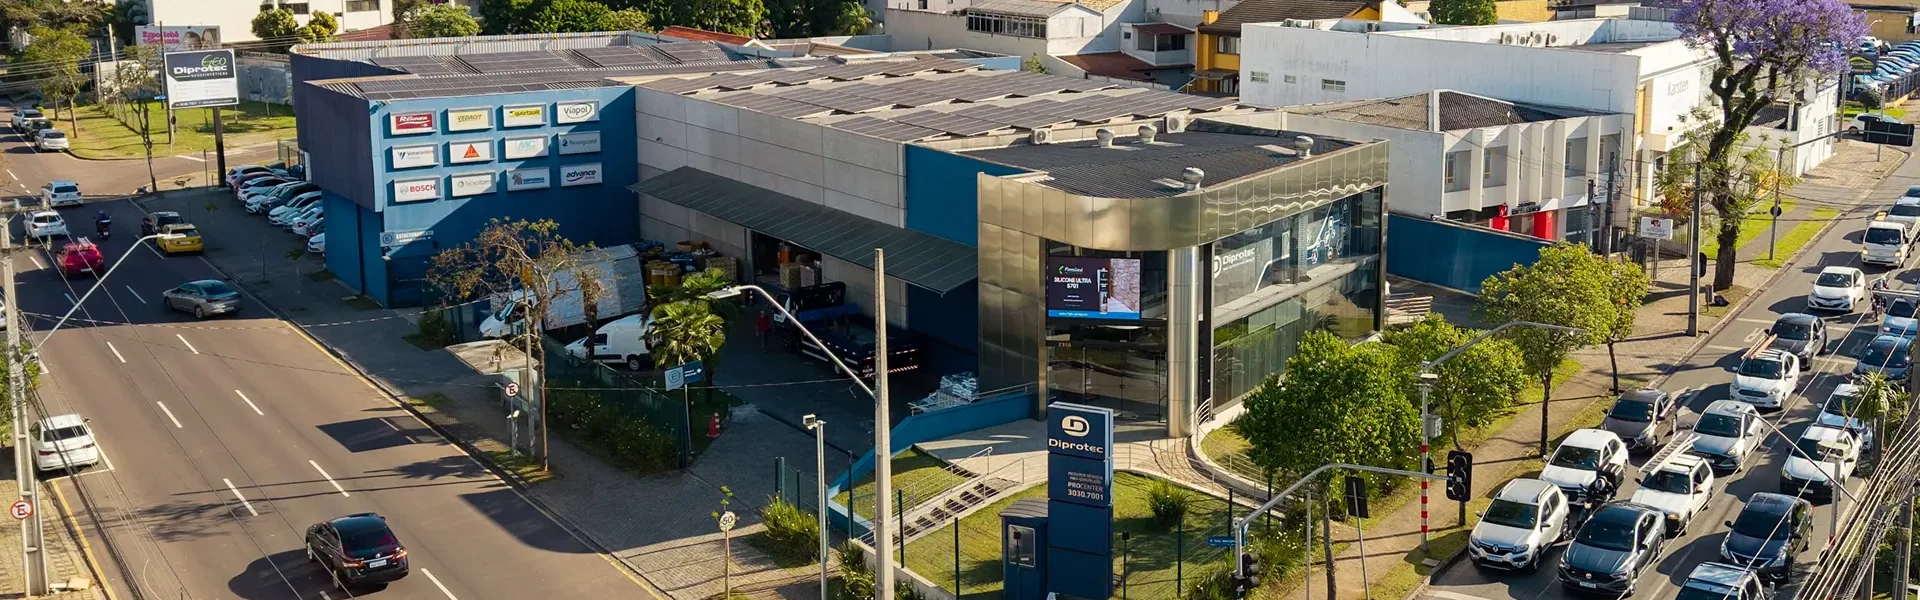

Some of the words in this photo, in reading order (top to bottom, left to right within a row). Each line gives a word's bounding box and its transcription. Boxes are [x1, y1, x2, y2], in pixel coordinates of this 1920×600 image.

[174, 65, 227, 74] Diprotec
[564, 104, 588, 115] Viapol
[566, 169, 596, 178] advance
[410, 184, 436, 192] BOSCH
[1222, 247, 1255, 264] Diprotec
[1048, 438, 1104, 453] Diprotec
[1068, 482, 1104, 492] PROCENTER
[1068, 488, 1104, 500] 3030.7001
[721, 516, 733, 525] 50
